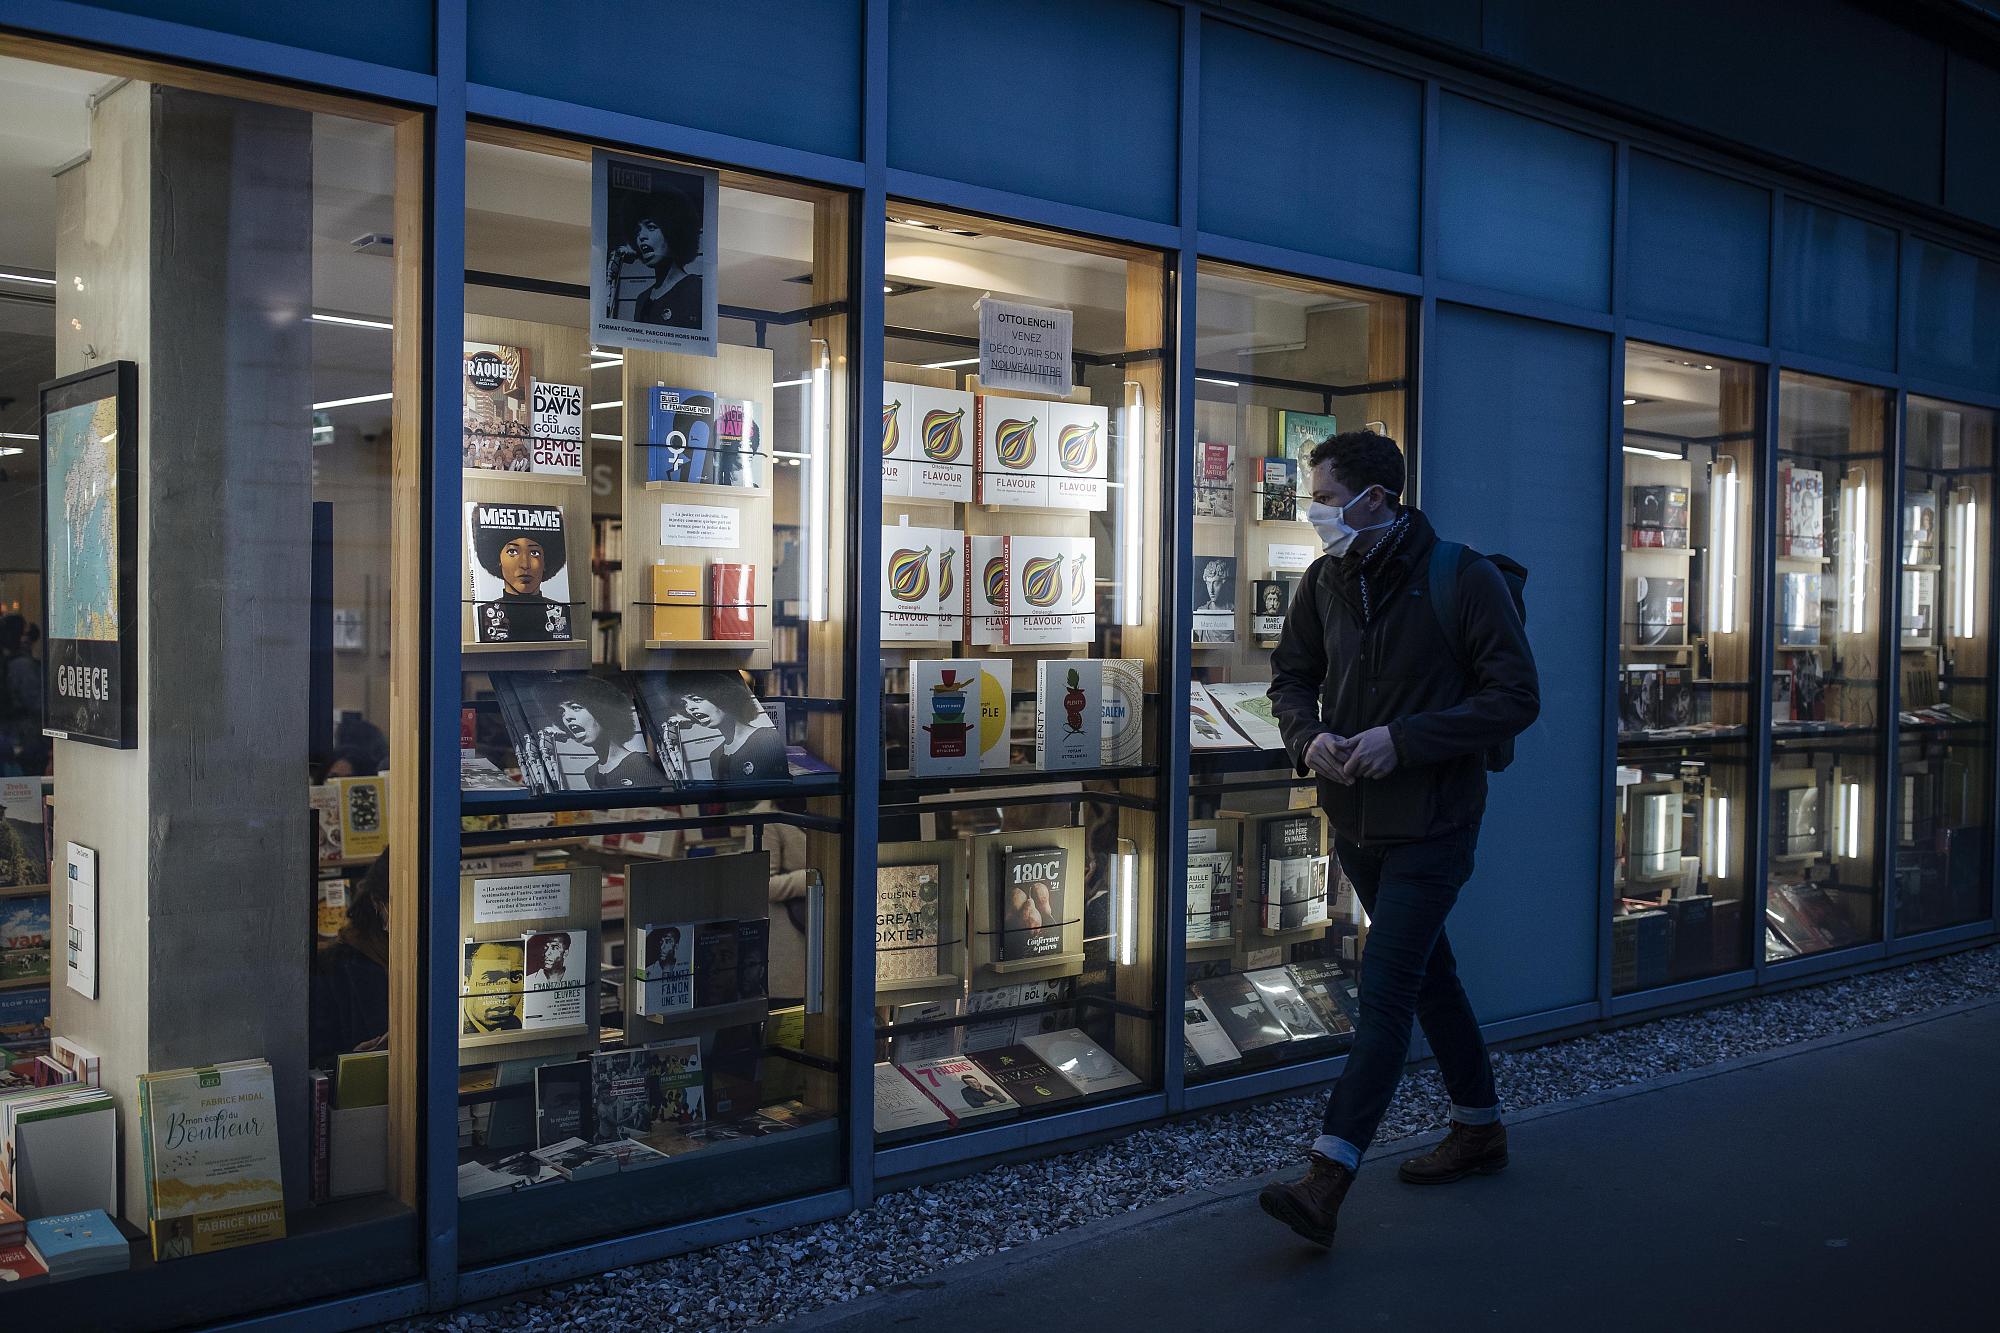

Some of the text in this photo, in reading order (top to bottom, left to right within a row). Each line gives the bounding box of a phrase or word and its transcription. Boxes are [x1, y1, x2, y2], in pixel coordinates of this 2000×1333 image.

[998, 313, 1056, 330] OTTOLENGHI
[599, 323, 620, 331] FORMAT
[645, 330, 674, 338] PARCOURS
[1012, 330, 1042, 343] VENEZ
[989, 342, 1063, 361] DÉCOUVRIR SON
[991, 359, 1062, 376] NOUVEAU TITRE
[534, 384, 580, 398] ANGELA
[534, 395, 581, 417] DAVIS
[661, 395, 679, 403] BLUES
[542, 414, 558, 424] LES
[534, 423, 581, 436] GOULAGS
[534, 434, 581, 453] DÉMO-
[534, 452, 581, 467] CRATIE
[922, 470, 962, 482] FLAVOUR
[996, 478, 1036, 488] FLAVOUR
[1059, 482, 1097, 492] FLAVOUR
[480, 507, 560, 528] MISS DAVIS
[889, 612, 929, 622] FLAVOUR
[939, 612, 952, 622] UR
[1023, 617, 1062, 626] FLAVOUR
[57, 664, 109, 701] GREECE
[982, 707, 999, 718] PLE
[1013, 860, 1060, 884] 180°C
[881, 890, 917, 900] CUISINE
[876, 911, 922, 926] GREAT
[8, 934, 43, 949] van
[1038, 943, 1058, 954] poires
[534, 979, 581, 991] FRANTZ FANON
[662, 981, 689, 996] FANON
[662, 993, 689, 1007] UNE VIE
[1025, 989, 1040, 1001] BOL
[913, 1068, 941, 1088] 7
[201, 1091, 264, 1107] FABRICE MIDAL
[185, 1116, 203, 1125] mon
[228, 1111, 238, 1119] du
[165, 1108, 265, 1150] Bonheur
[197, 1217, 245, 1233] FABRICE
[248, 1211, 282, 1225] MIDAL
